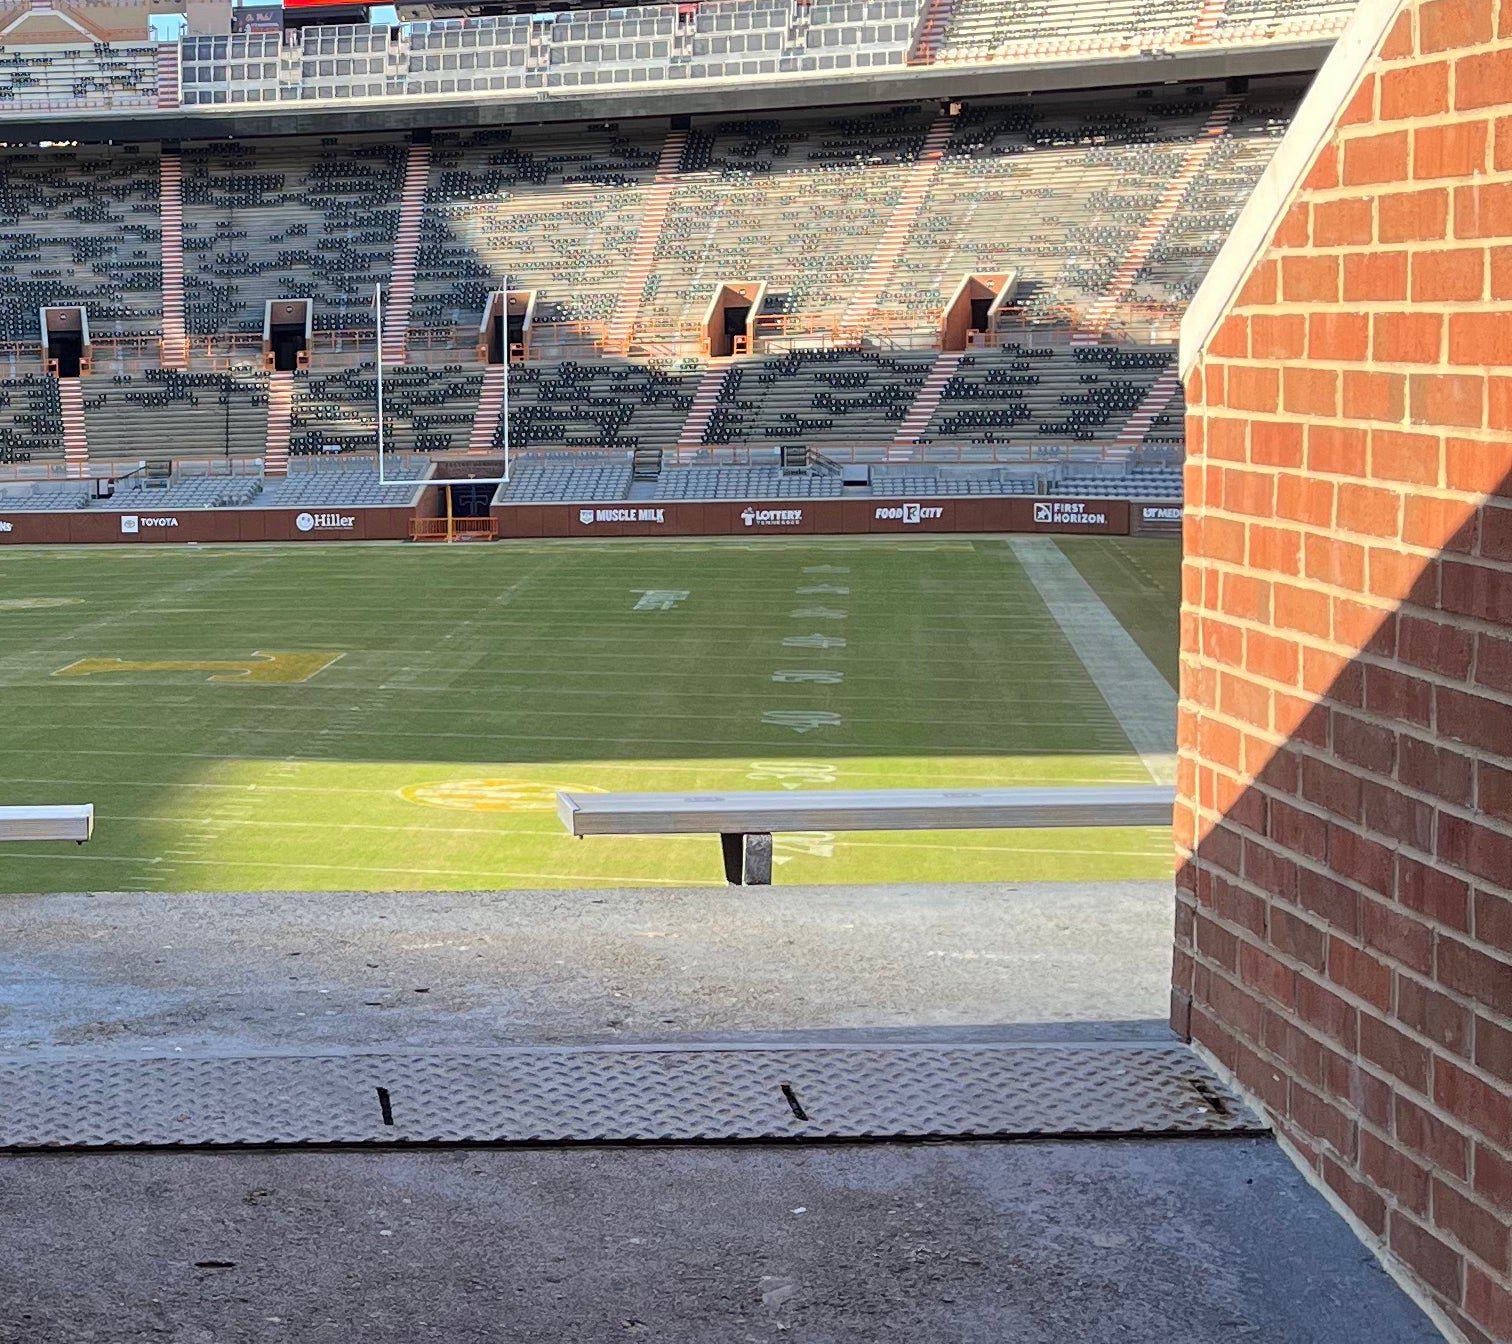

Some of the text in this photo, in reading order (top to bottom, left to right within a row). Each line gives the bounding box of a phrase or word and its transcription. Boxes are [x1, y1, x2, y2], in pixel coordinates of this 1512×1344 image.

[875, 507, 903, 519] FOOD
[920, 507, 943, 519] CITY
[1053, 503, 1085, 513] FIRST
[313, 513, 355, 527] Hiller
[596, 509, 664, 523] MUSCLE MILK
[1053, 513, 1106, 524] HORIZON
[140, 517, 178, 527] TOYOTA
